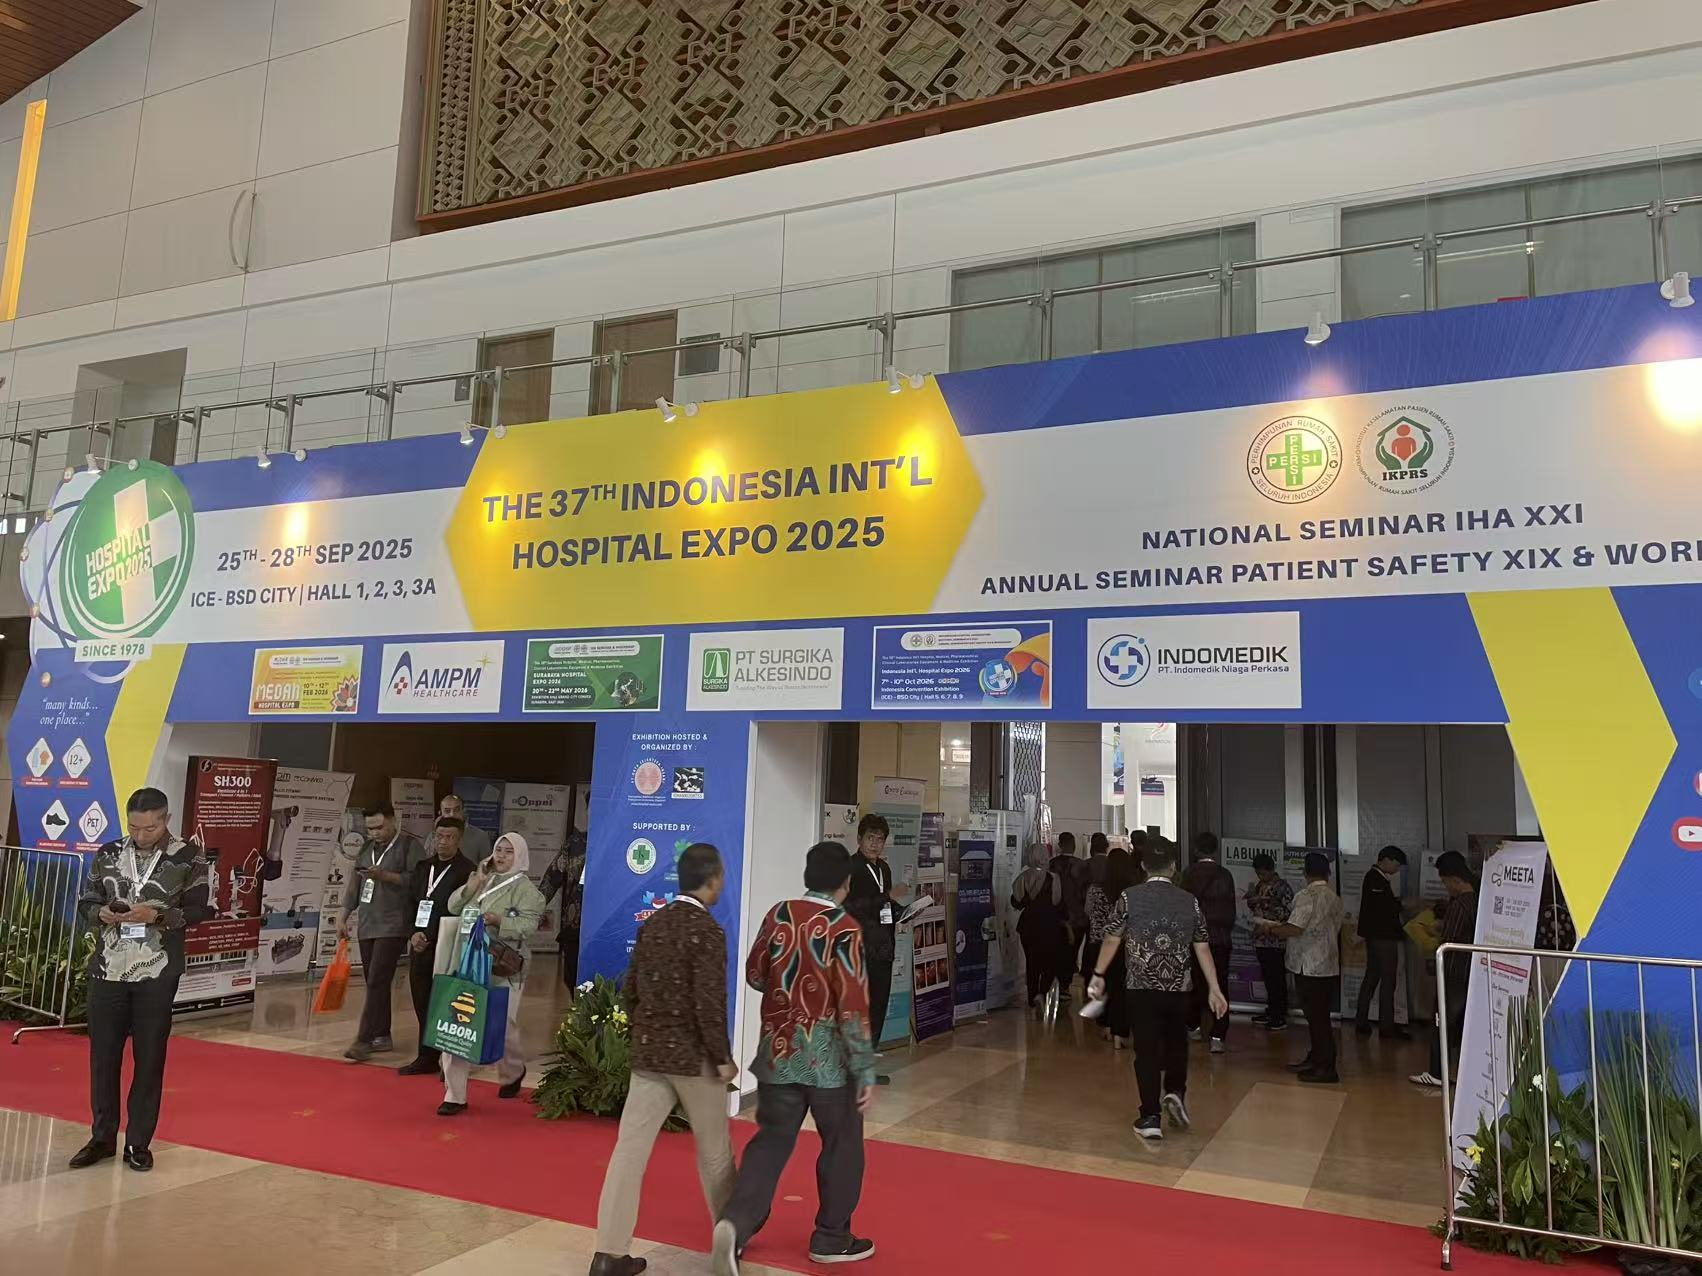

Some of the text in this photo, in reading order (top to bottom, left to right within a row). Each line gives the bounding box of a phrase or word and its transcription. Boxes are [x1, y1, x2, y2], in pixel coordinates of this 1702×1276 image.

[1251, 419, 1338, 464] PERHIMPUNAN RUMAH SAKIT
[1269, 454, 1316, 467] PERSI
[1290, 436, 1299, 485] PERSI
[1382, 469, 1428, 481] IKPRS
[483, 492, 543, 522] THE
[548, 483, 616, 518] 37TH
[621, 466, 818, 512] INDONESIA
[1256, 473, 1334, 500] SELURUH INDONESIA
[1141, 503, 1584, 551] NATIONAL SEMINAR IHA XXI
[86, 522, 152, 576] HOSPITAL
[512, 516, 885, 569] HOSPITAL EXPO 2025
[217, 549, 257, 571] 25TH
[270, 545, 311, 568] 28TH
[315, 542, 354, 564] SEP
[357, 538, 413, 561] 2025
[980, 573, 1088, 595] ANNUAL
[1096, 565, 1223, 589] SEMINAR
[1232, 558, 1358, 583] PATIENT
[1367, 550, 1493, 577] SAFETY
[1502, 547, 1563, 570] XIX
[1572, 545, 1595, 567] &
[191, 591, 215, 607] ICE
[226, 589, 256, 606] BSD
[260, 586, 297, 603] CITY
[307, 584, 351, 601] HALL
[356, 582, 369, 600] 1,
[373, 580, 388, 599] 2,
[392, 579, 407, 598] 3,
[412, 578, 436, 596] 3A
[82, 644, 145, 657] SINCE 1978
[736, 648, 833, 665] PT SURGIKA
[1158, 646, 1288, 665] INDOMEDIK
[414, 668, 481, 689] AMPM
[734, 666, 831, 682] ALKESINDO
[1222, 665, 1248, 674] Niaga
[413, 689, 478, 697] HEALTHCARE
[40, 715, 53, 725] one
[69, 754, 83, 765] 12+
[214, 775, 251, 787] SH300
[87, 818, 100, 828] PET
[633, 823, 678, 831] SUPPORTED
[680, 823, 691, 831] BY
[1503, 866, 1534, 883] MEETA
[437, 1019, 477, 1042] LABORA
